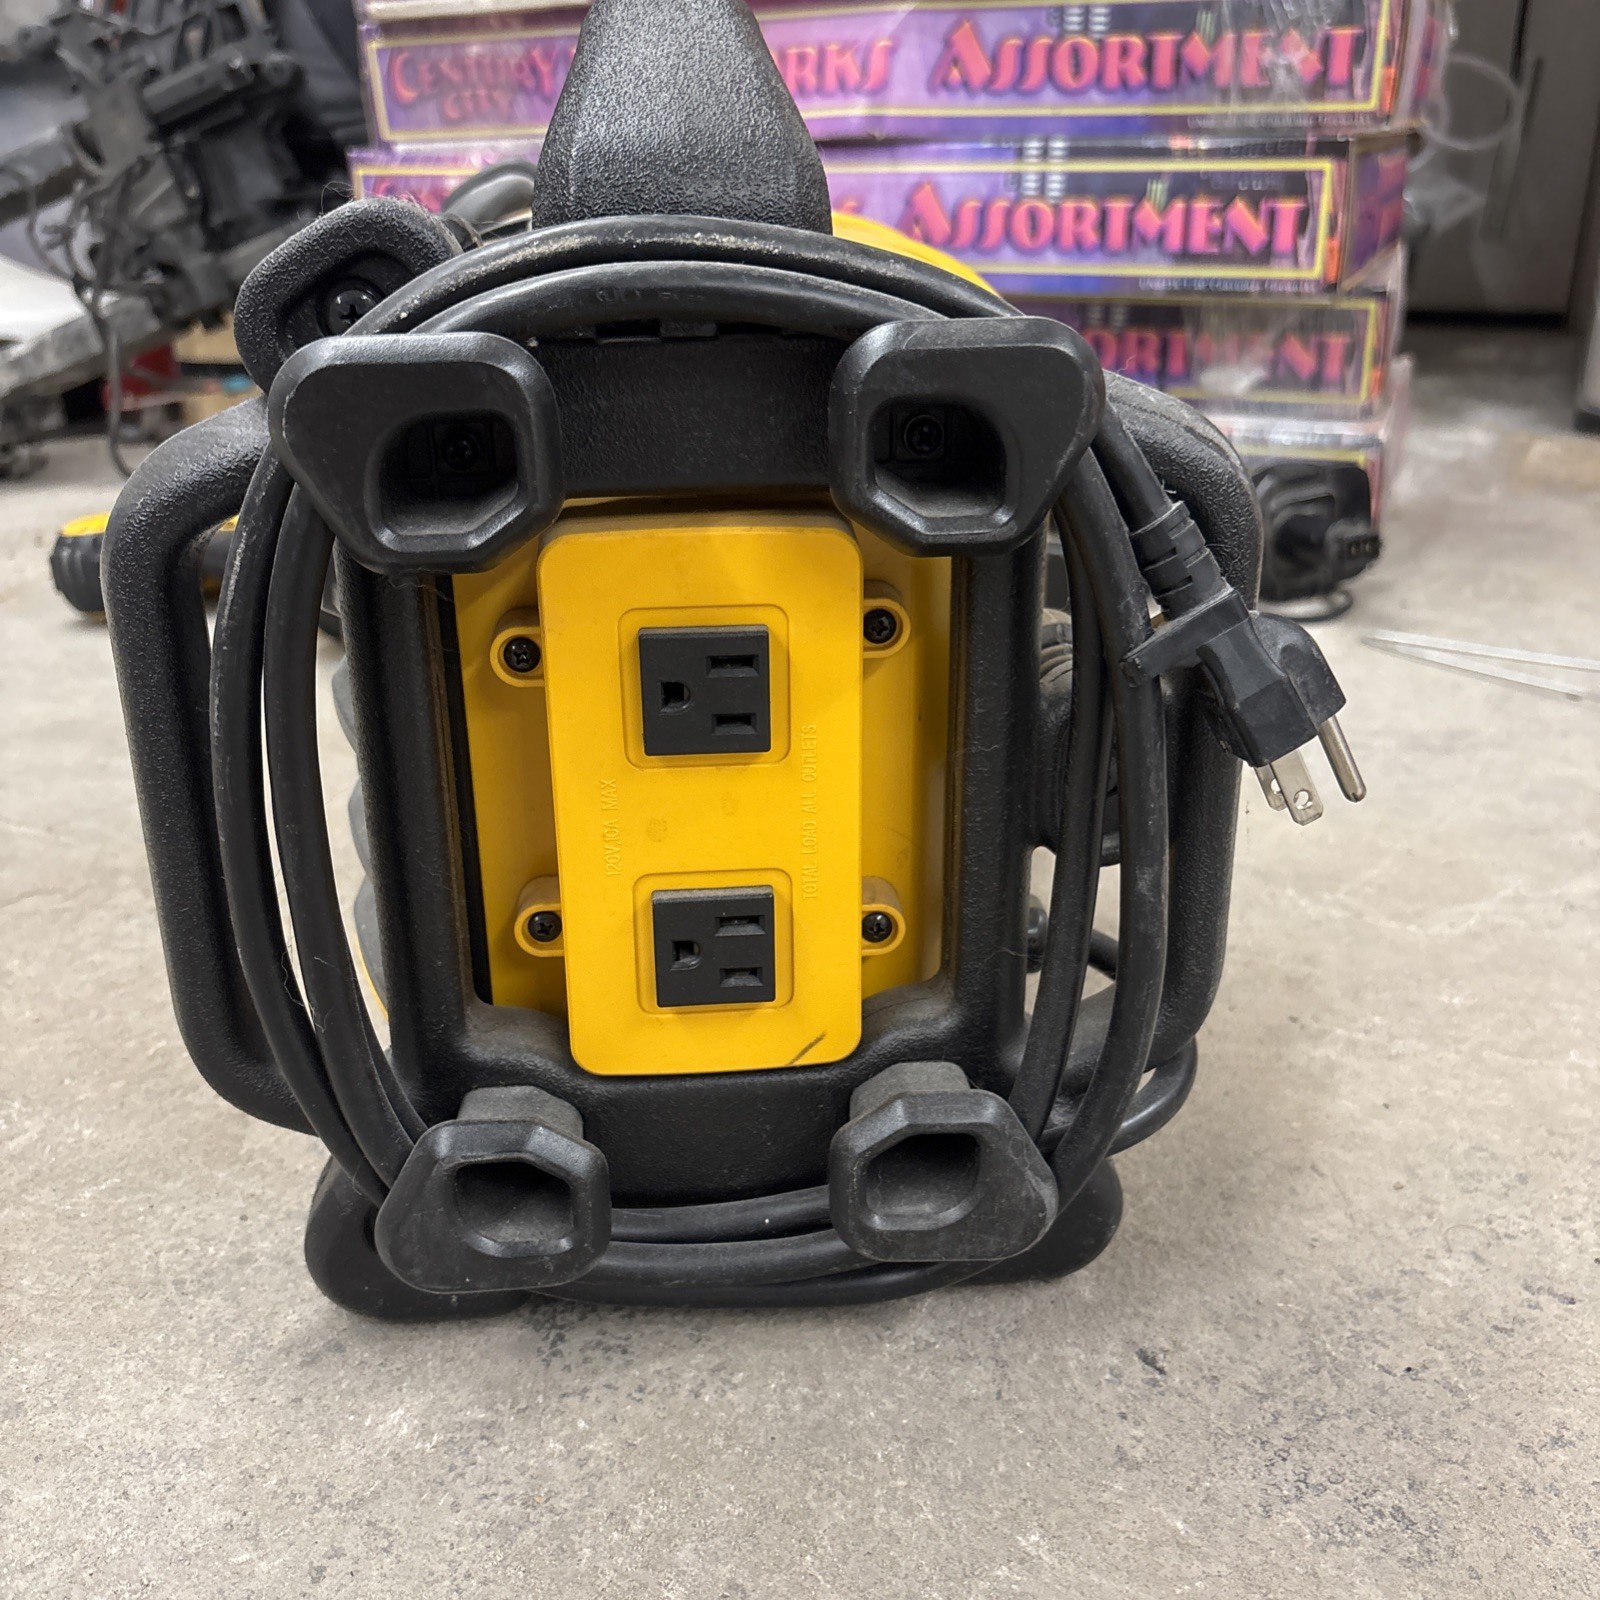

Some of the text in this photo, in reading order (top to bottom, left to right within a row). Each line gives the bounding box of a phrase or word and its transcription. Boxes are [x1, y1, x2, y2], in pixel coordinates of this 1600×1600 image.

[900, 182, 1308, 254] ASSORTMENT
[600, 778, 618, 811] MAX
[801, 723, 818, 900] TOTAL LOAD ALL OUTLETS
